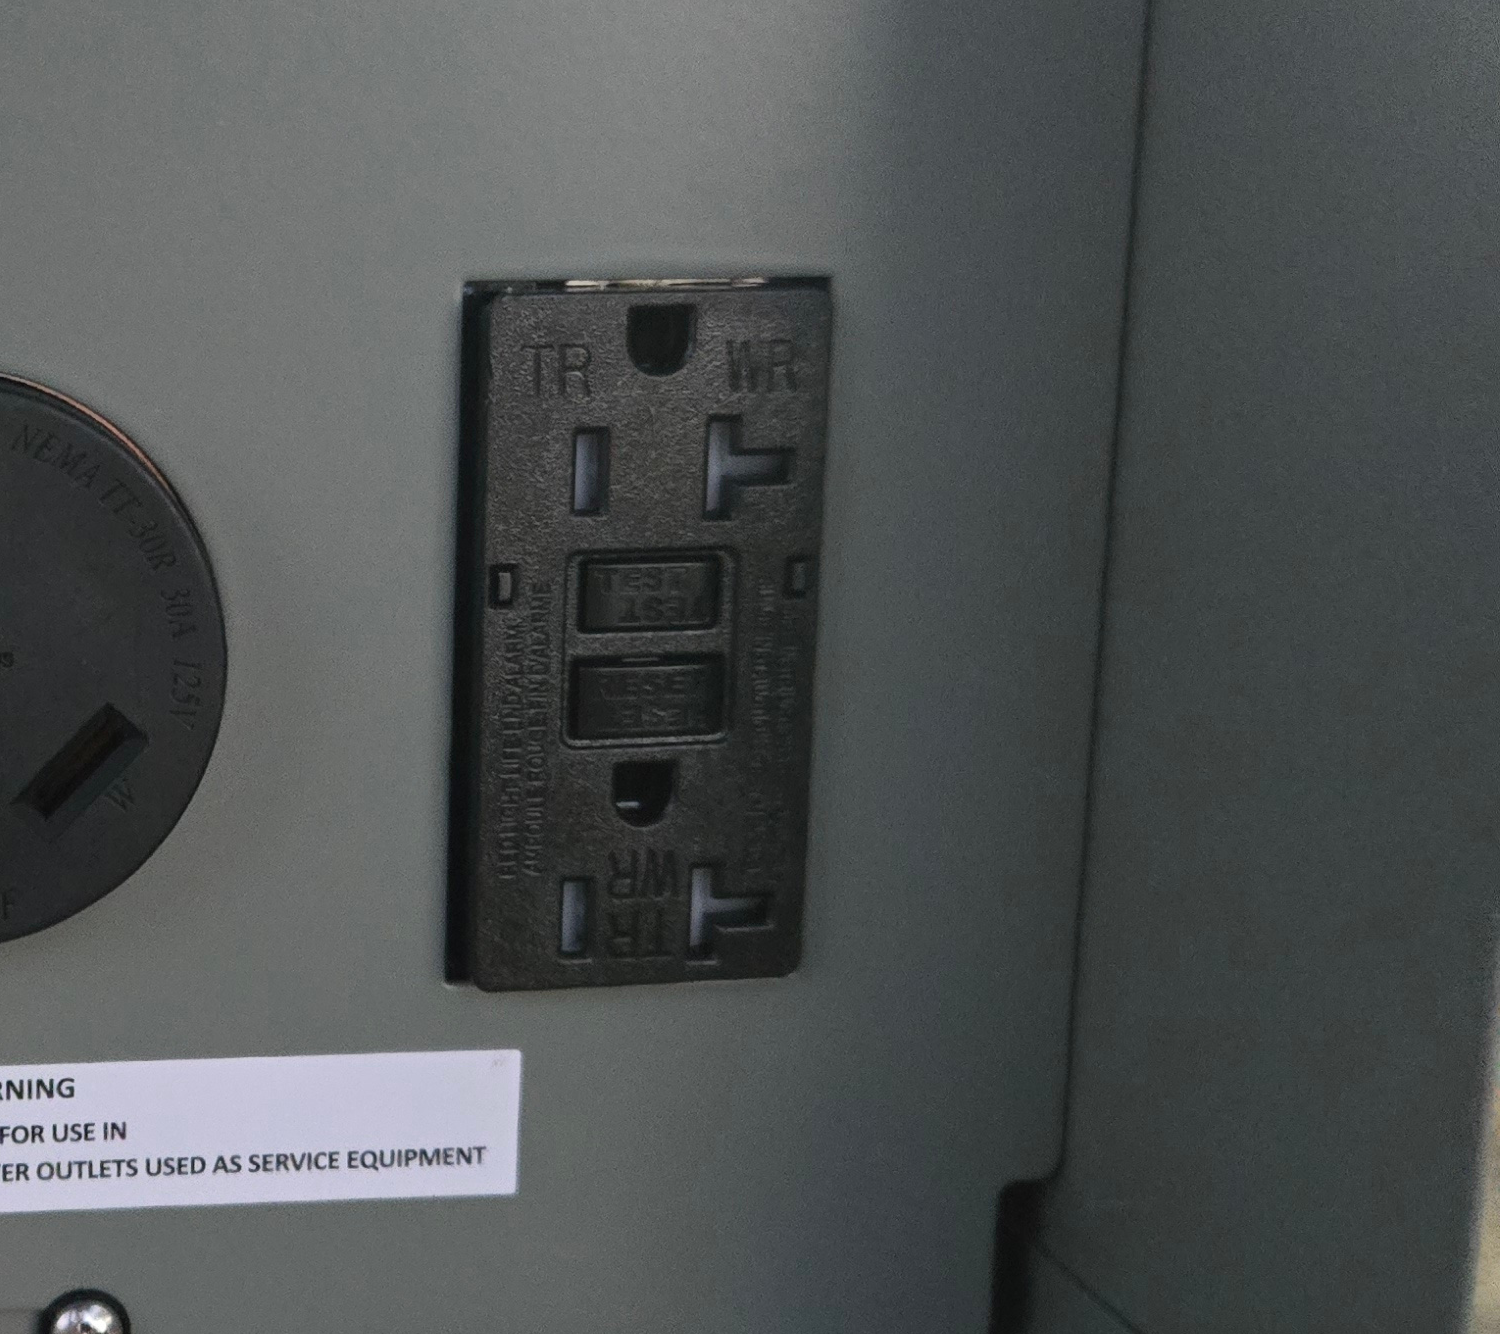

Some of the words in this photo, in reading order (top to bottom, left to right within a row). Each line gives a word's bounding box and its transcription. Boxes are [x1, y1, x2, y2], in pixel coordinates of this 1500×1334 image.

[521, 343, 591, 396] TR
[726, 338, 798, 391] WR
[10, 423, 103, 489] NEMA
[100, 477, 178, 572] TT-30R
[593, 567, 688, 594] TEST
[160, 587, 198, 639] 30A
[169, 659, 203, 731] 125V
[608, 848, 682, 899] WR
[52, 1121, 96, 1143] USE
[102, 1120, 128, 1142] IN
[36, 1158, 138, 1183] OUTLETS
[145, 1154, 207, 1178] USED
[212, 1153, 242, 1175] AS
[248, 1149, 340, 1174] SERVICE
[346, 1145, 487, 1173] EQUIPMENT
